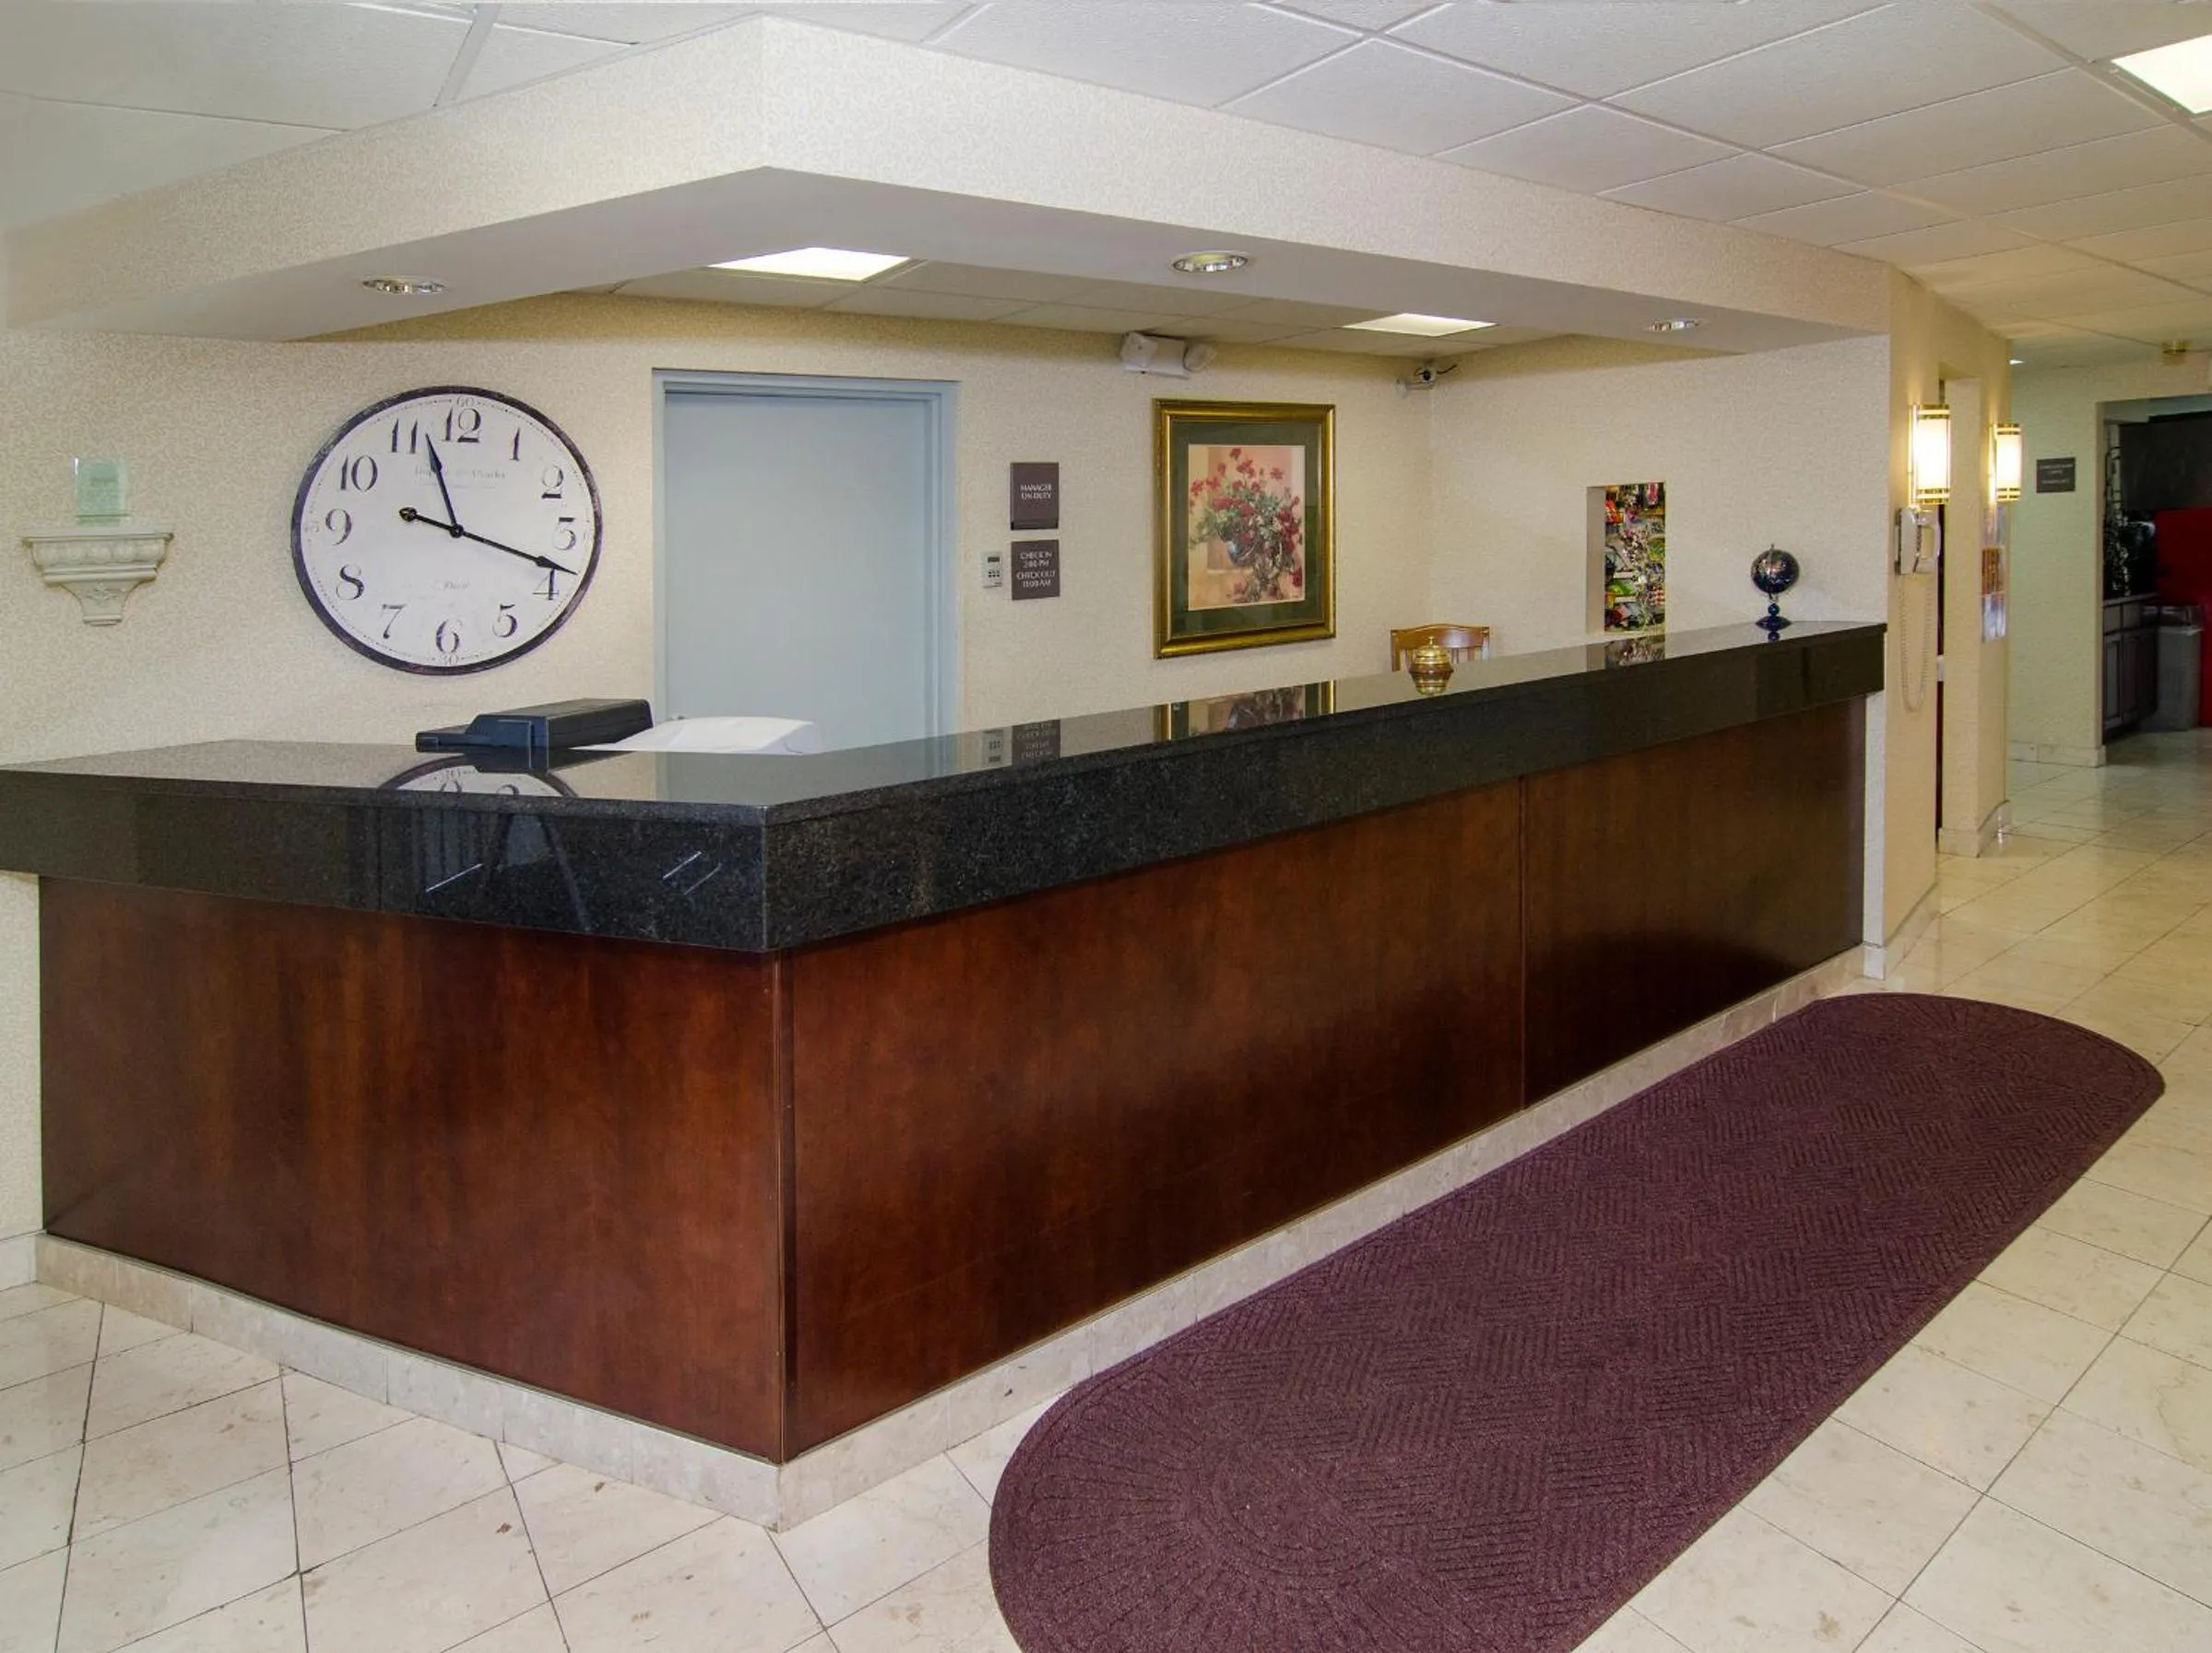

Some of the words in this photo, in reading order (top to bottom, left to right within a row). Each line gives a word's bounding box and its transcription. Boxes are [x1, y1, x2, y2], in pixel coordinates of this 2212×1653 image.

[391, 419, 419, 455] 11
[442, 407, 481, 443] 12
[510, 427, 522, 461] 1
[340, 455, 378, 491] 10
[541, 464, 564, 500] 2
[1020, 483, 1052, 491] MANAGER
[325, 508, 352, 546] 9
[553, 516, 576, 551] 3
[336, 564, 365, 600] 8
[532, 568, 560, 600] 4
[382, 604, 407, 639] 7
[435, 619, 463, 655] 6
[491, 604, 517, 638] 5
